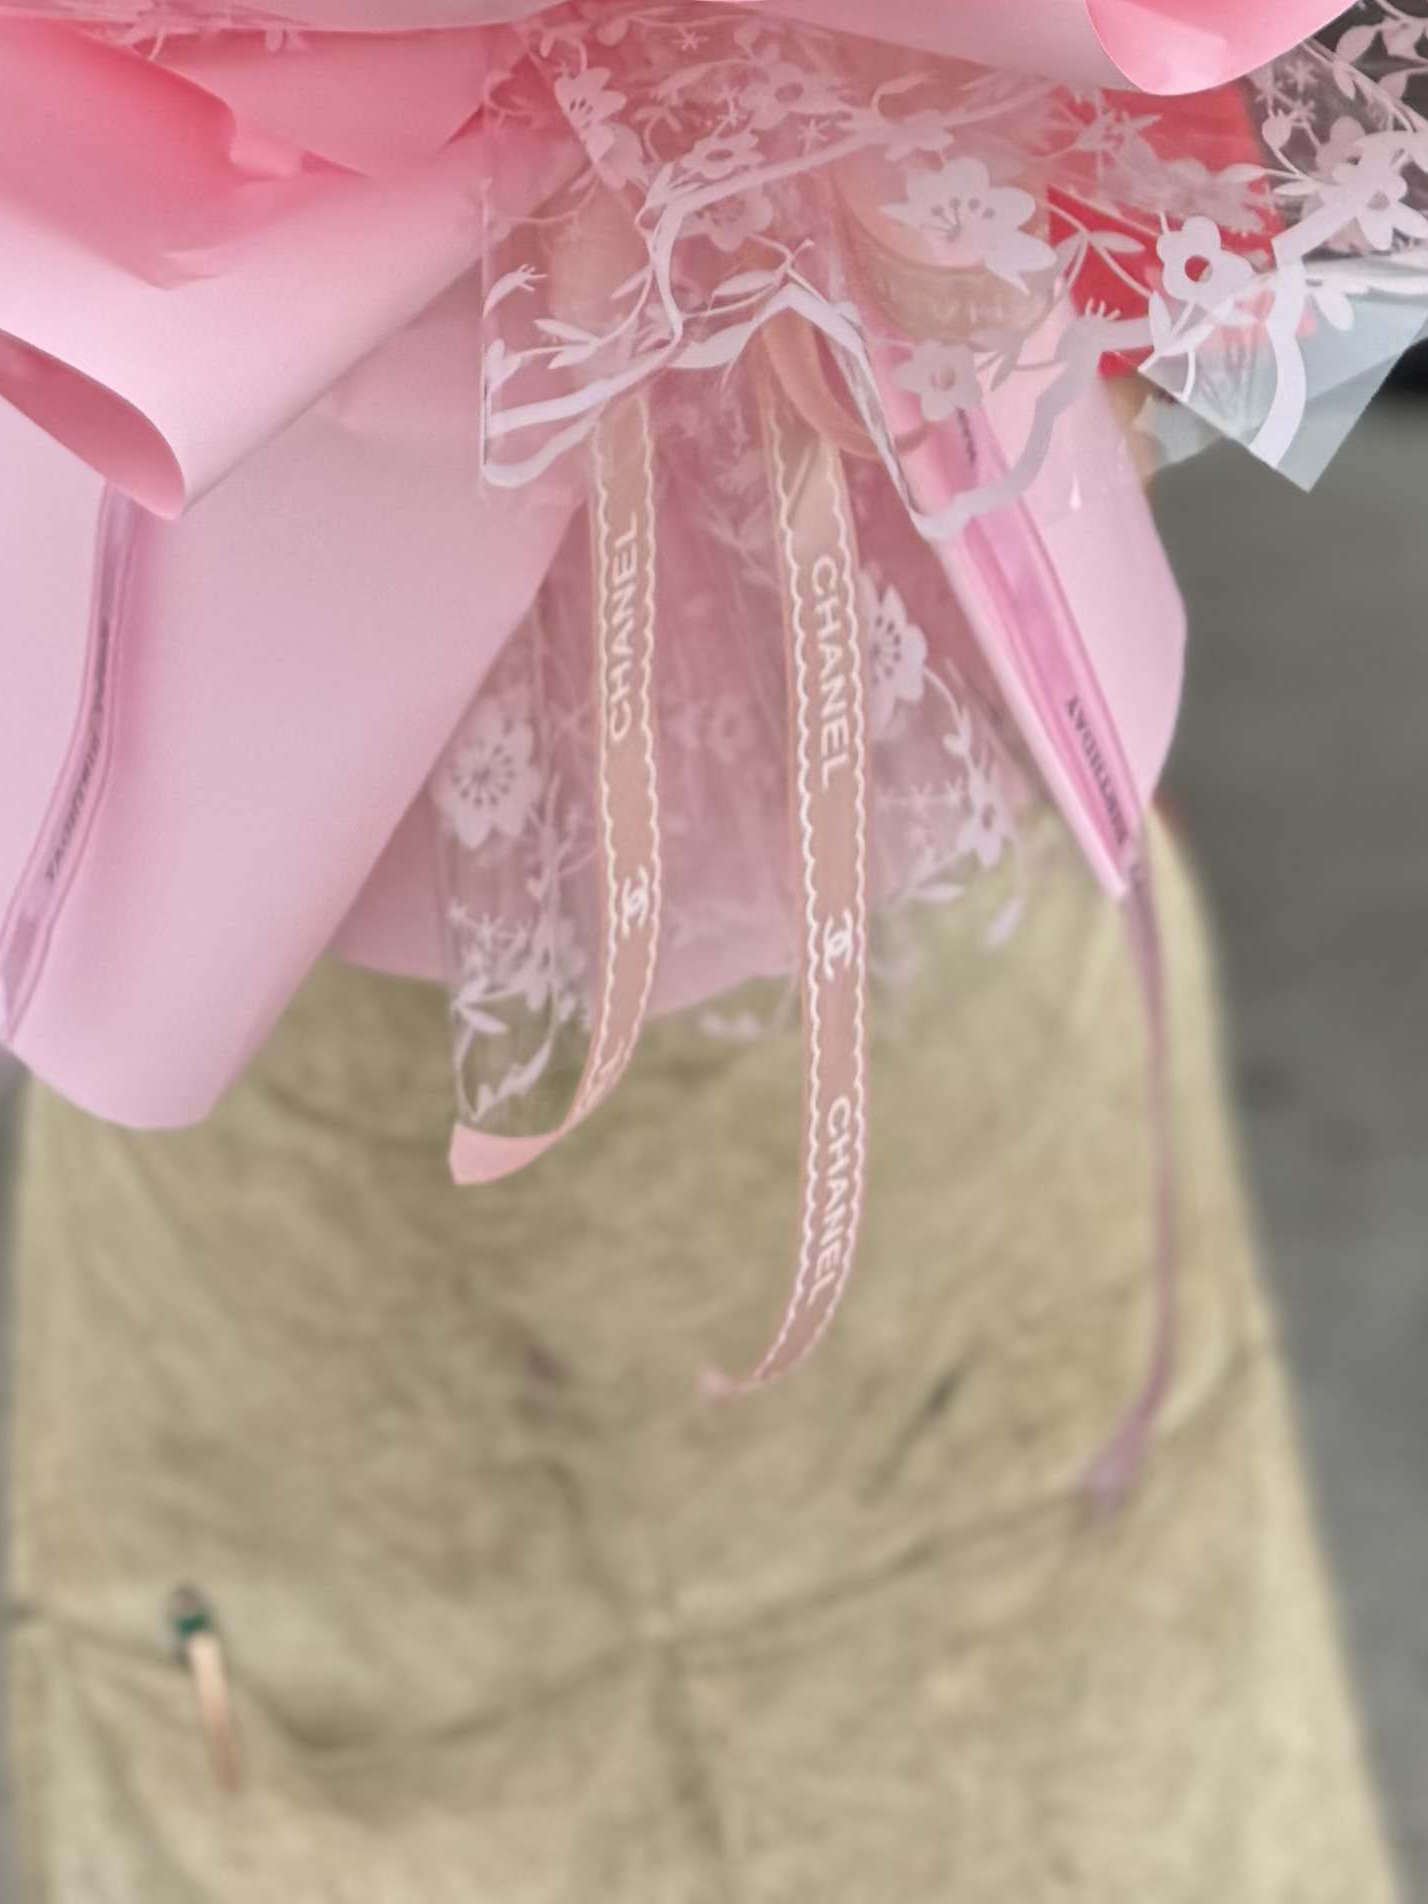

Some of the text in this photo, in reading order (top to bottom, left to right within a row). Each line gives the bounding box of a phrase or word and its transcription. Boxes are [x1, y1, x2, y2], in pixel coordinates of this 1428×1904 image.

[608, 510, 639, 742] CHANEL
[810, 554, 851, 790] CHANEL
[808, 1095, 853, 1307] CHANEL
